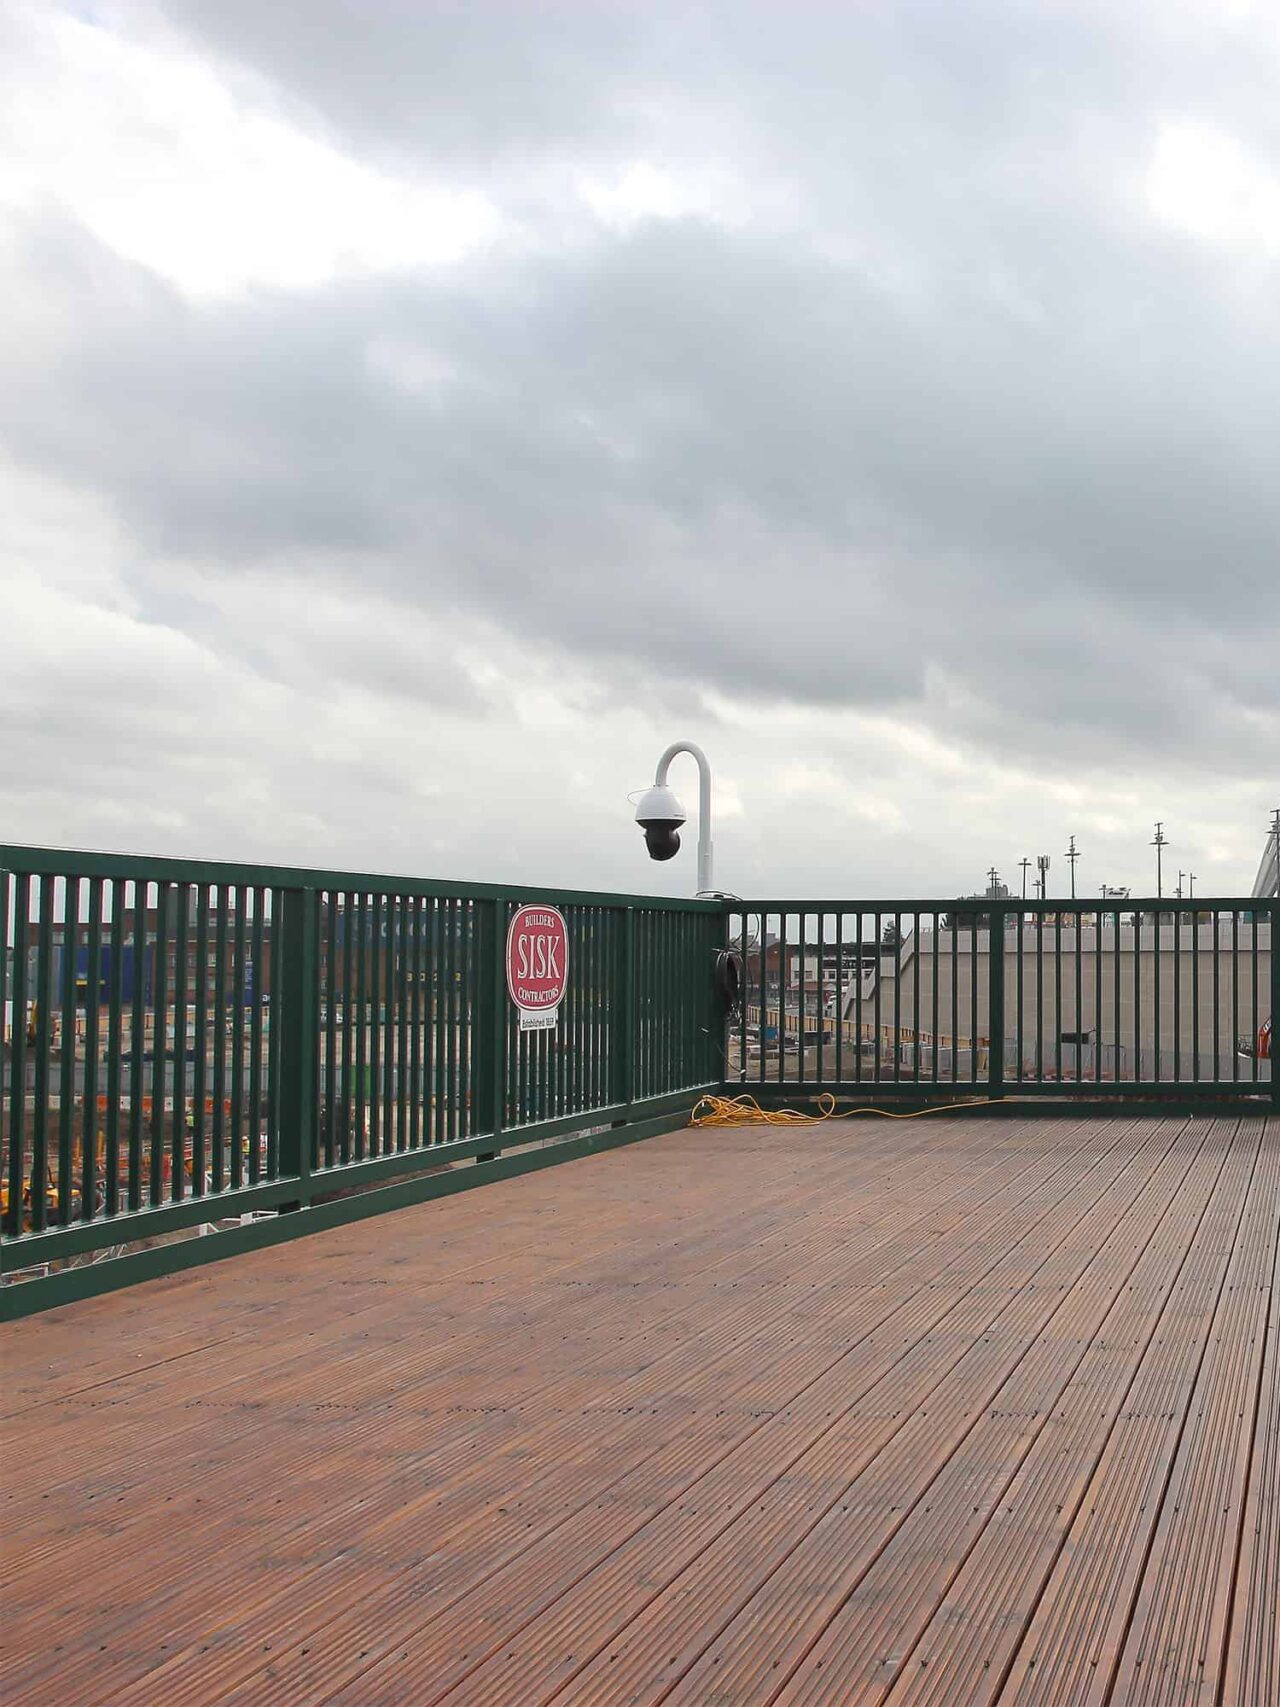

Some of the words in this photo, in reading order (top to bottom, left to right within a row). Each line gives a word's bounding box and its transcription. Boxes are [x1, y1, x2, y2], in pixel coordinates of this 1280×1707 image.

[525, 914, 555, 928] BUILDERS
[517, 934, 560, 979] SISK
[518, 985, 559, 1002] CONTRACTORS
